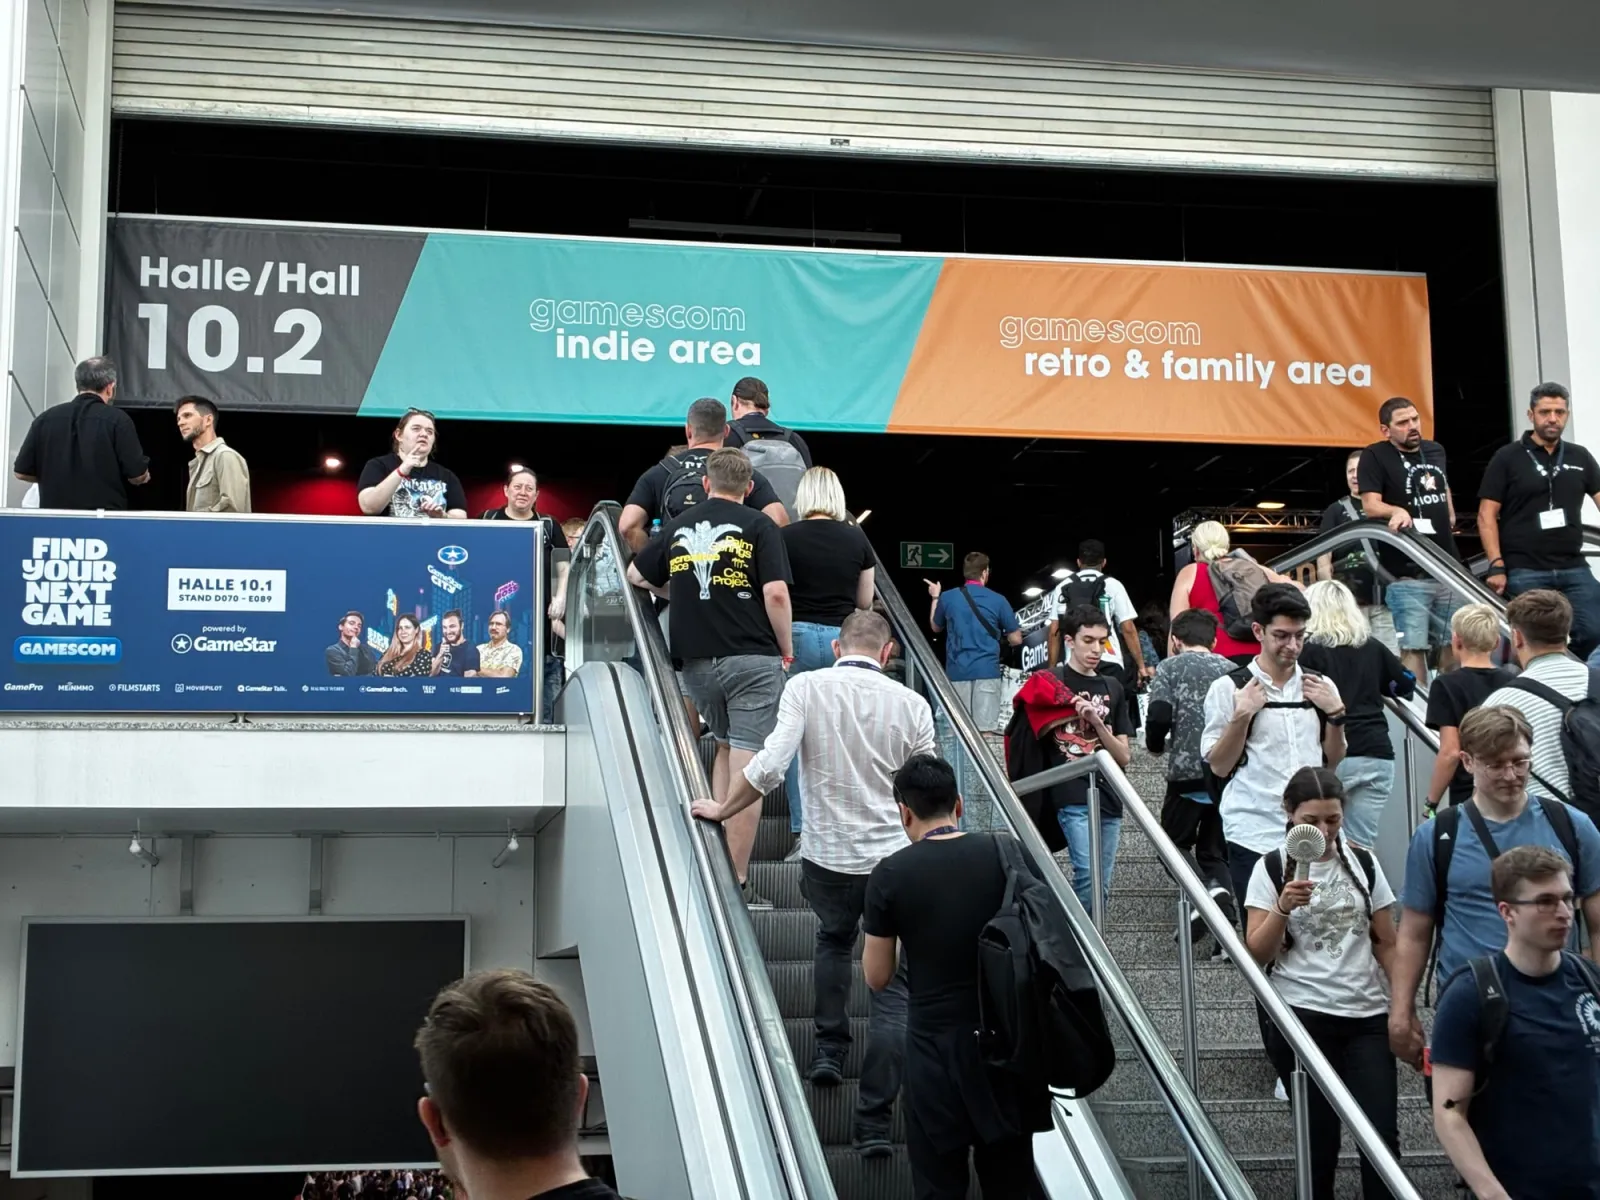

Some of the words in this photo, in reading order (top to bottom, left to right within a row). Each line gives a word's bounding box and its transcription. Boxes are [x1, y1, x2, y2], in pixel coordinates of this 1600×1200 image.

[140, 256, 360, 296] Halle/Hall
[529, 298, 746, 332] gamescom
[138, 303, 322, 375] 10.2
[1000, 316, 1200, 348] gamescom
[556, 328, 656, 361] indie
[668, 339, 761, 366] area
[1025, 348, 1111, 378] retro
[1124, 349, 1150, 379] &
[1162, 350, 1275, 389] family
[1287, 362, 1371, 387] area
[32, 537, 108, 560] FIND
[22, 559, 117, 582] YOUR
[25, 581, 112, 604] NEXT
[178, 578, 235, 591] HALLE
[241, 579, 272, 592] 10.1
[178, 594, 212, 602] STAND
[214, 594, 239, 602] D070
[248, 595, 272, 603] E089
[21, 604, 111, 626] GAME
[202, 625, 235, 634] powered
[237, 625, 247, 634] by
[19, 642, 116, 656] GAMESCOM
[194, 636, 277, 653] GameStar
[4, 683, 44, 692] GamePro
[117, 684, 160, 692] FILMSTARTS
